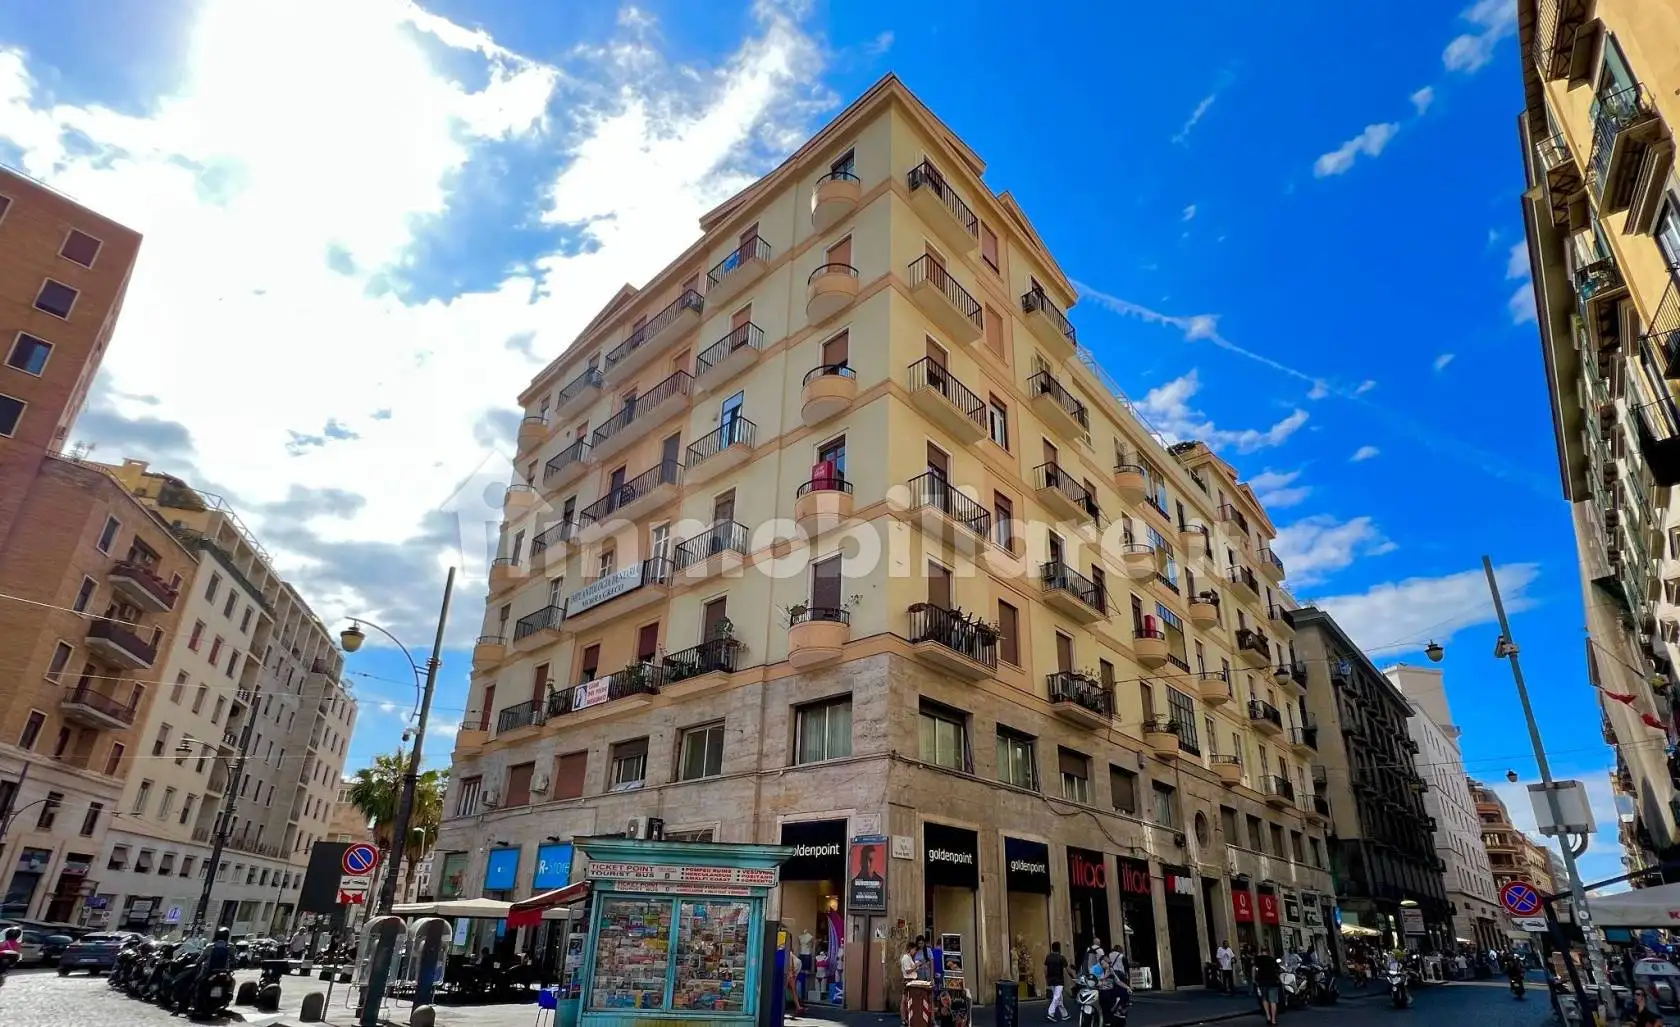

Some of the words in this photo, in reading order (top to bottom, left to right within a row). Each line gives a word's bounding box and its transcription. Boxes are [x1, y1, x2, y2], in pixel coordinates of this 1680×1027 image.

[792, 843, 841, 859] oldenpoint
[928, 848, 973, 864] goldenpoint
[1010, 860, 1047, 875] goldenpoint
